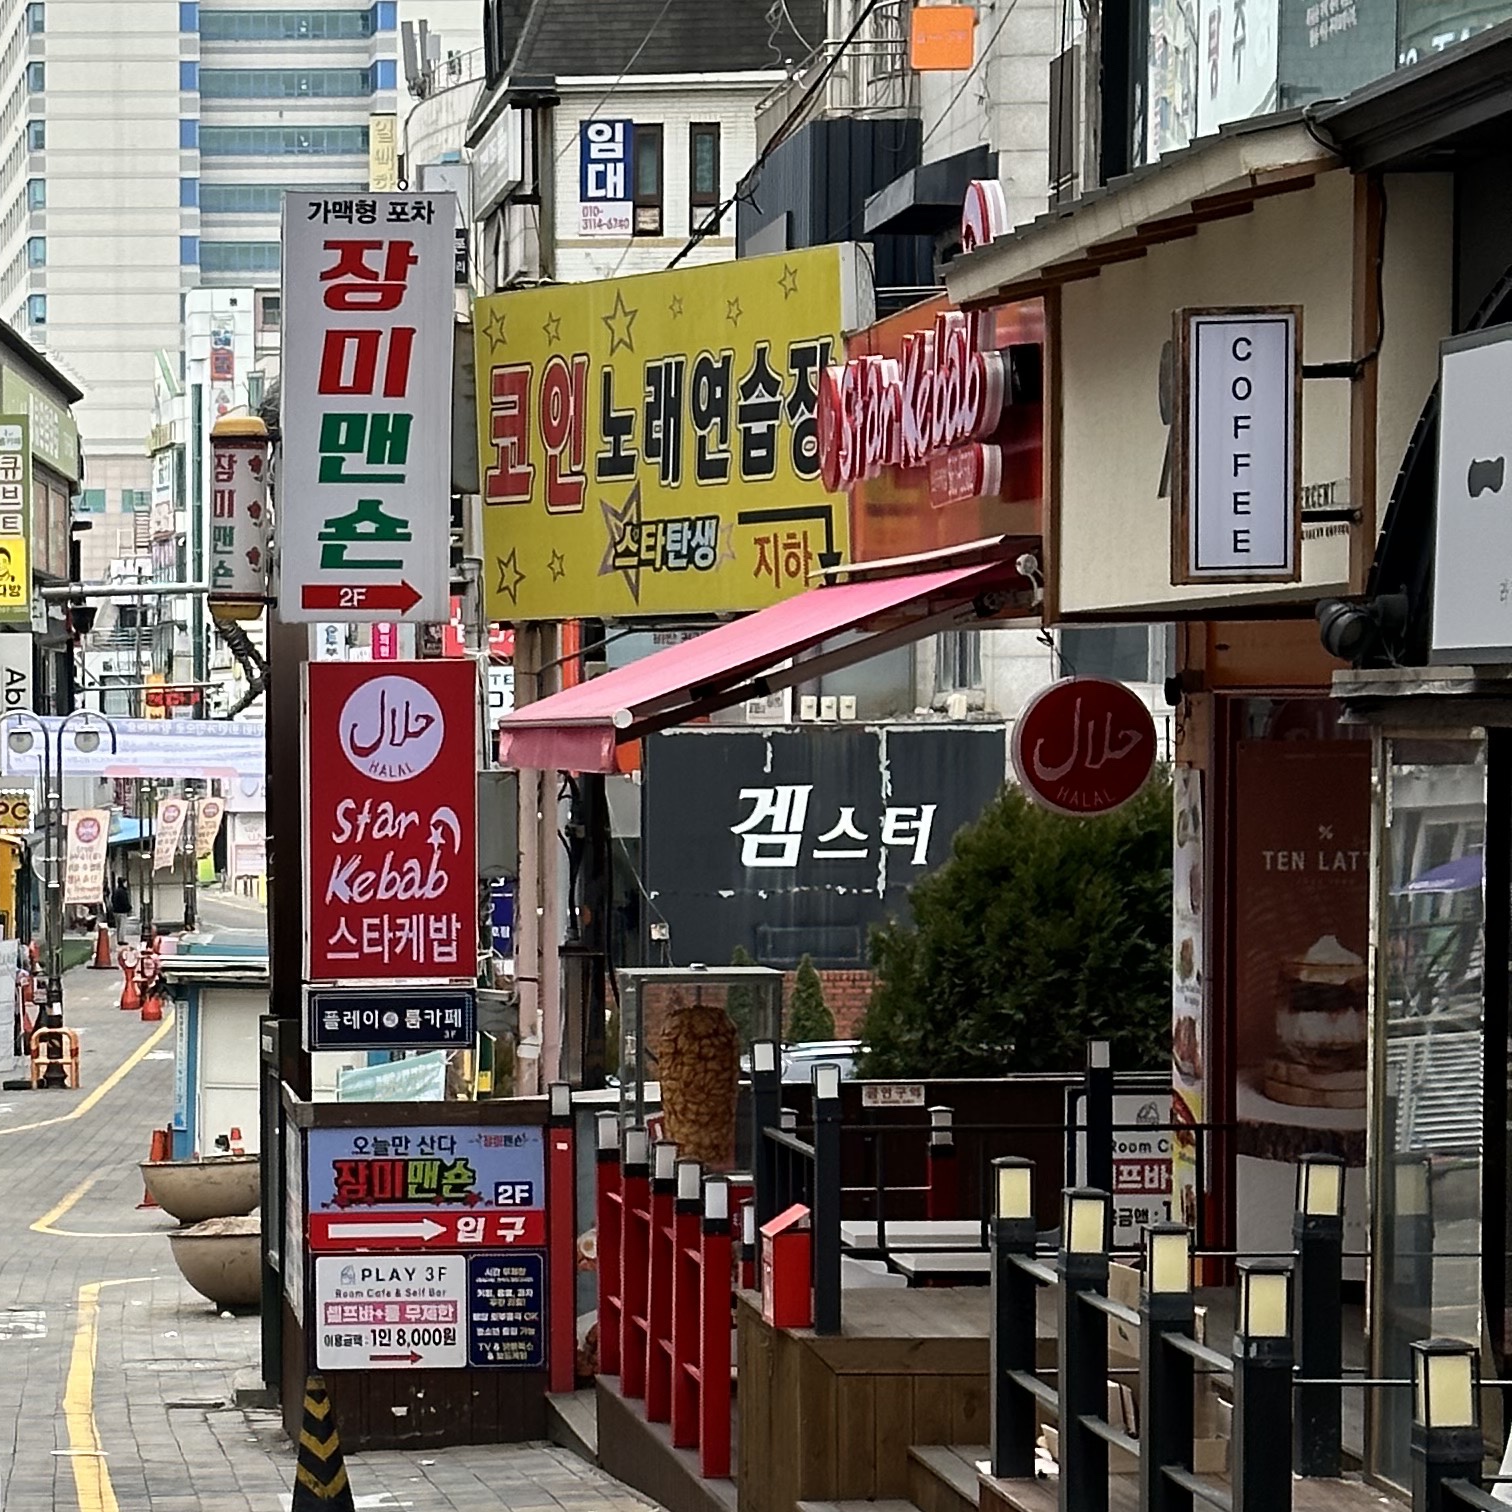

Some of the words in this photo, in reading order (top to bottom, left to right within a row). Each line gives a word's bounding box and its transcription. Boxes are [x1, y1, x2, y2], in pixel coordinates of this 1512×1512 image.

[588, 123, 624, 198] 임대
[308, 200, 376, 225] 가맥형
[387, 200, 434, 225] 포차
[1232, 336, 1252, 554] COFFEE
[612, 514, 720, 572] 스타탄생
[753, 532, 812, 587] 지하
[339, 587, 367, 607] 2F
[349, 690, 435, 758] حلال
[1032, 697, 1143, 780] حلال
[369, 760, 415, 778] HALAL
[1056, 785, 1115, 804] HALAL
[332, 798, 419, 845] Star
[731, 784, 938, 868] 겜스터
[1263, 850, 1305, 872] TEN
[326, 852, 449, 906] Kebab
[327, 913, 461, 963] 스타케밥
[322, 1010, 379, 1030] 플레이
[405, 1009, 462, 1030] 룸카페
[866, 1087, 922, 1100] 금연구역
[353, 1136, 410, 1156] 오늘만
[417, 1135, 457, 1153] 산다
[498, 1184, 530, 1204] 2F
[361, 1267, 416, 1282] PLAY
[425, 1267, 448, 1281] 3F
[335, 1289, 363, 1298] Room
[367, 1288, 391, 1298] Cafe
[406, 1288, 426, 1298] Self
[429, 1288, 446, 1297] Bar
[404, 1304, 455, 1323] 무제한
[371, 1328, 392, 1347] 1인
[397, 1327, 456, 1348] 8,000원
